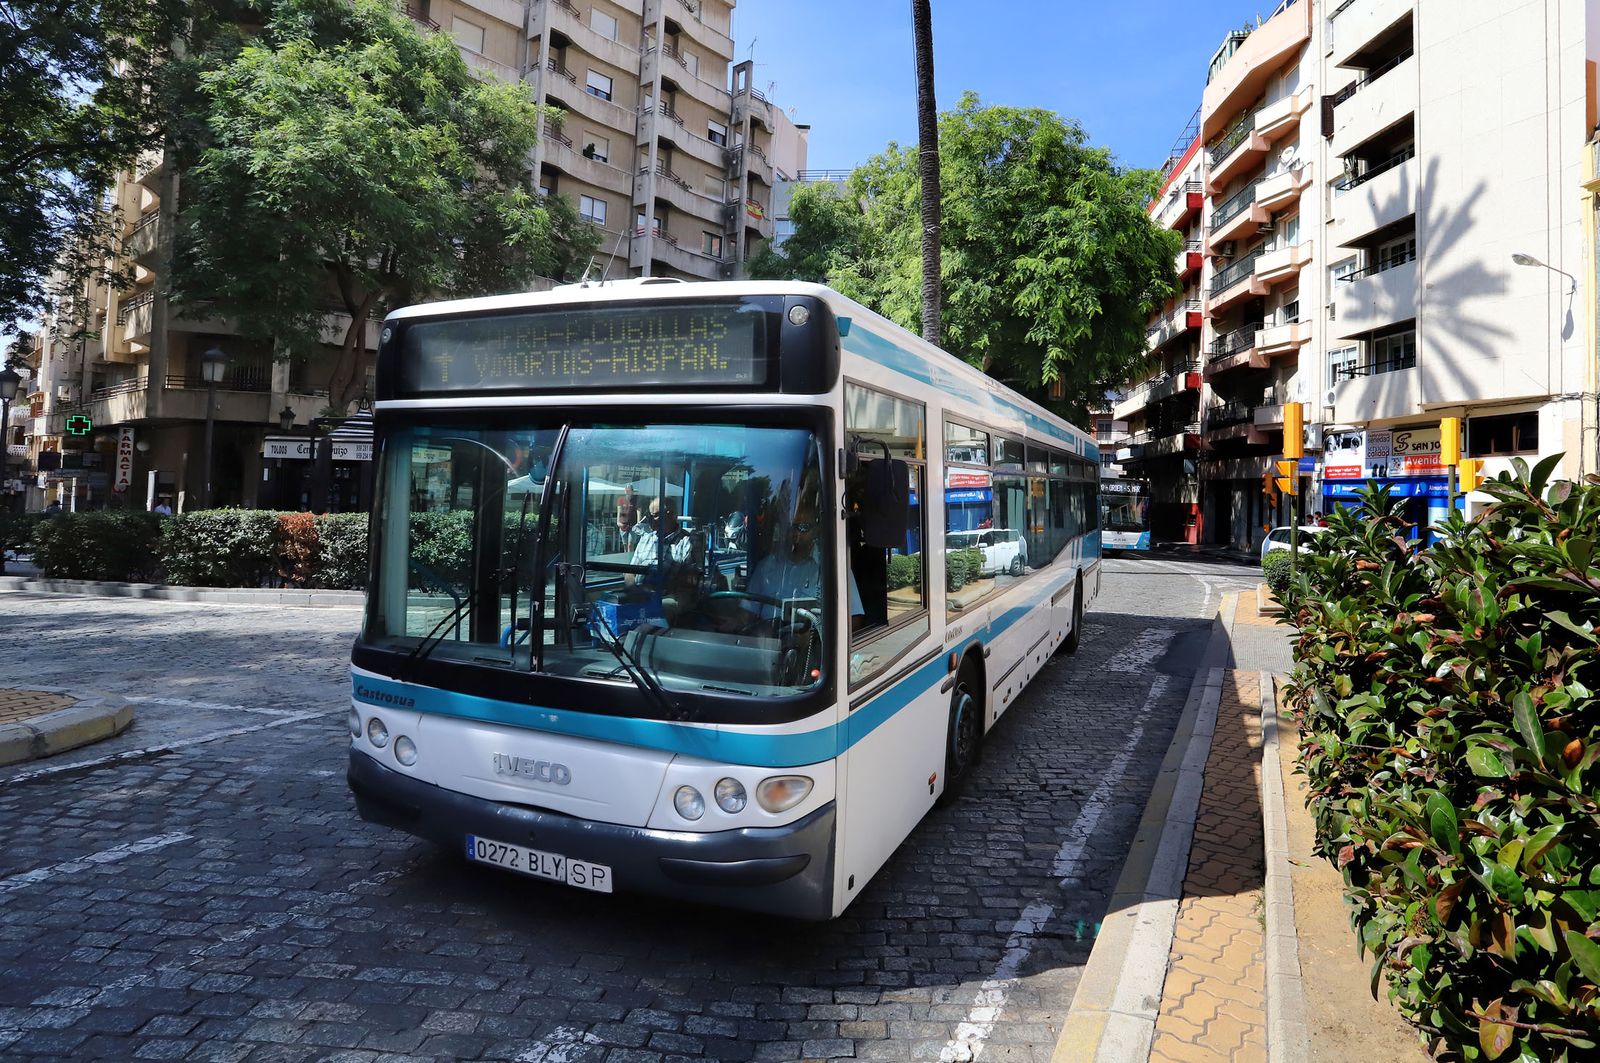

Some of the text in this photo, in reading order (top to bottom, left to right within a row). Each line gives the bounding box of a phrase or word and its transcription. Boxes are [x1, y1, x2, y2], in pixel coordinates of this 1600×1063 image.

[120, 429, 132, 484] FARMACIA
[271, 444, 288, 455] TOLDOS
[1411, 441, 1429, 451] SAN
[357, 684, 416, 708] Castrosua
[493, 752, 572, 785] IVECO
[476, 839, 519, 868] 0272
[528, 854, 563, 878] BLY
[571, 865, 606, 887] SP
